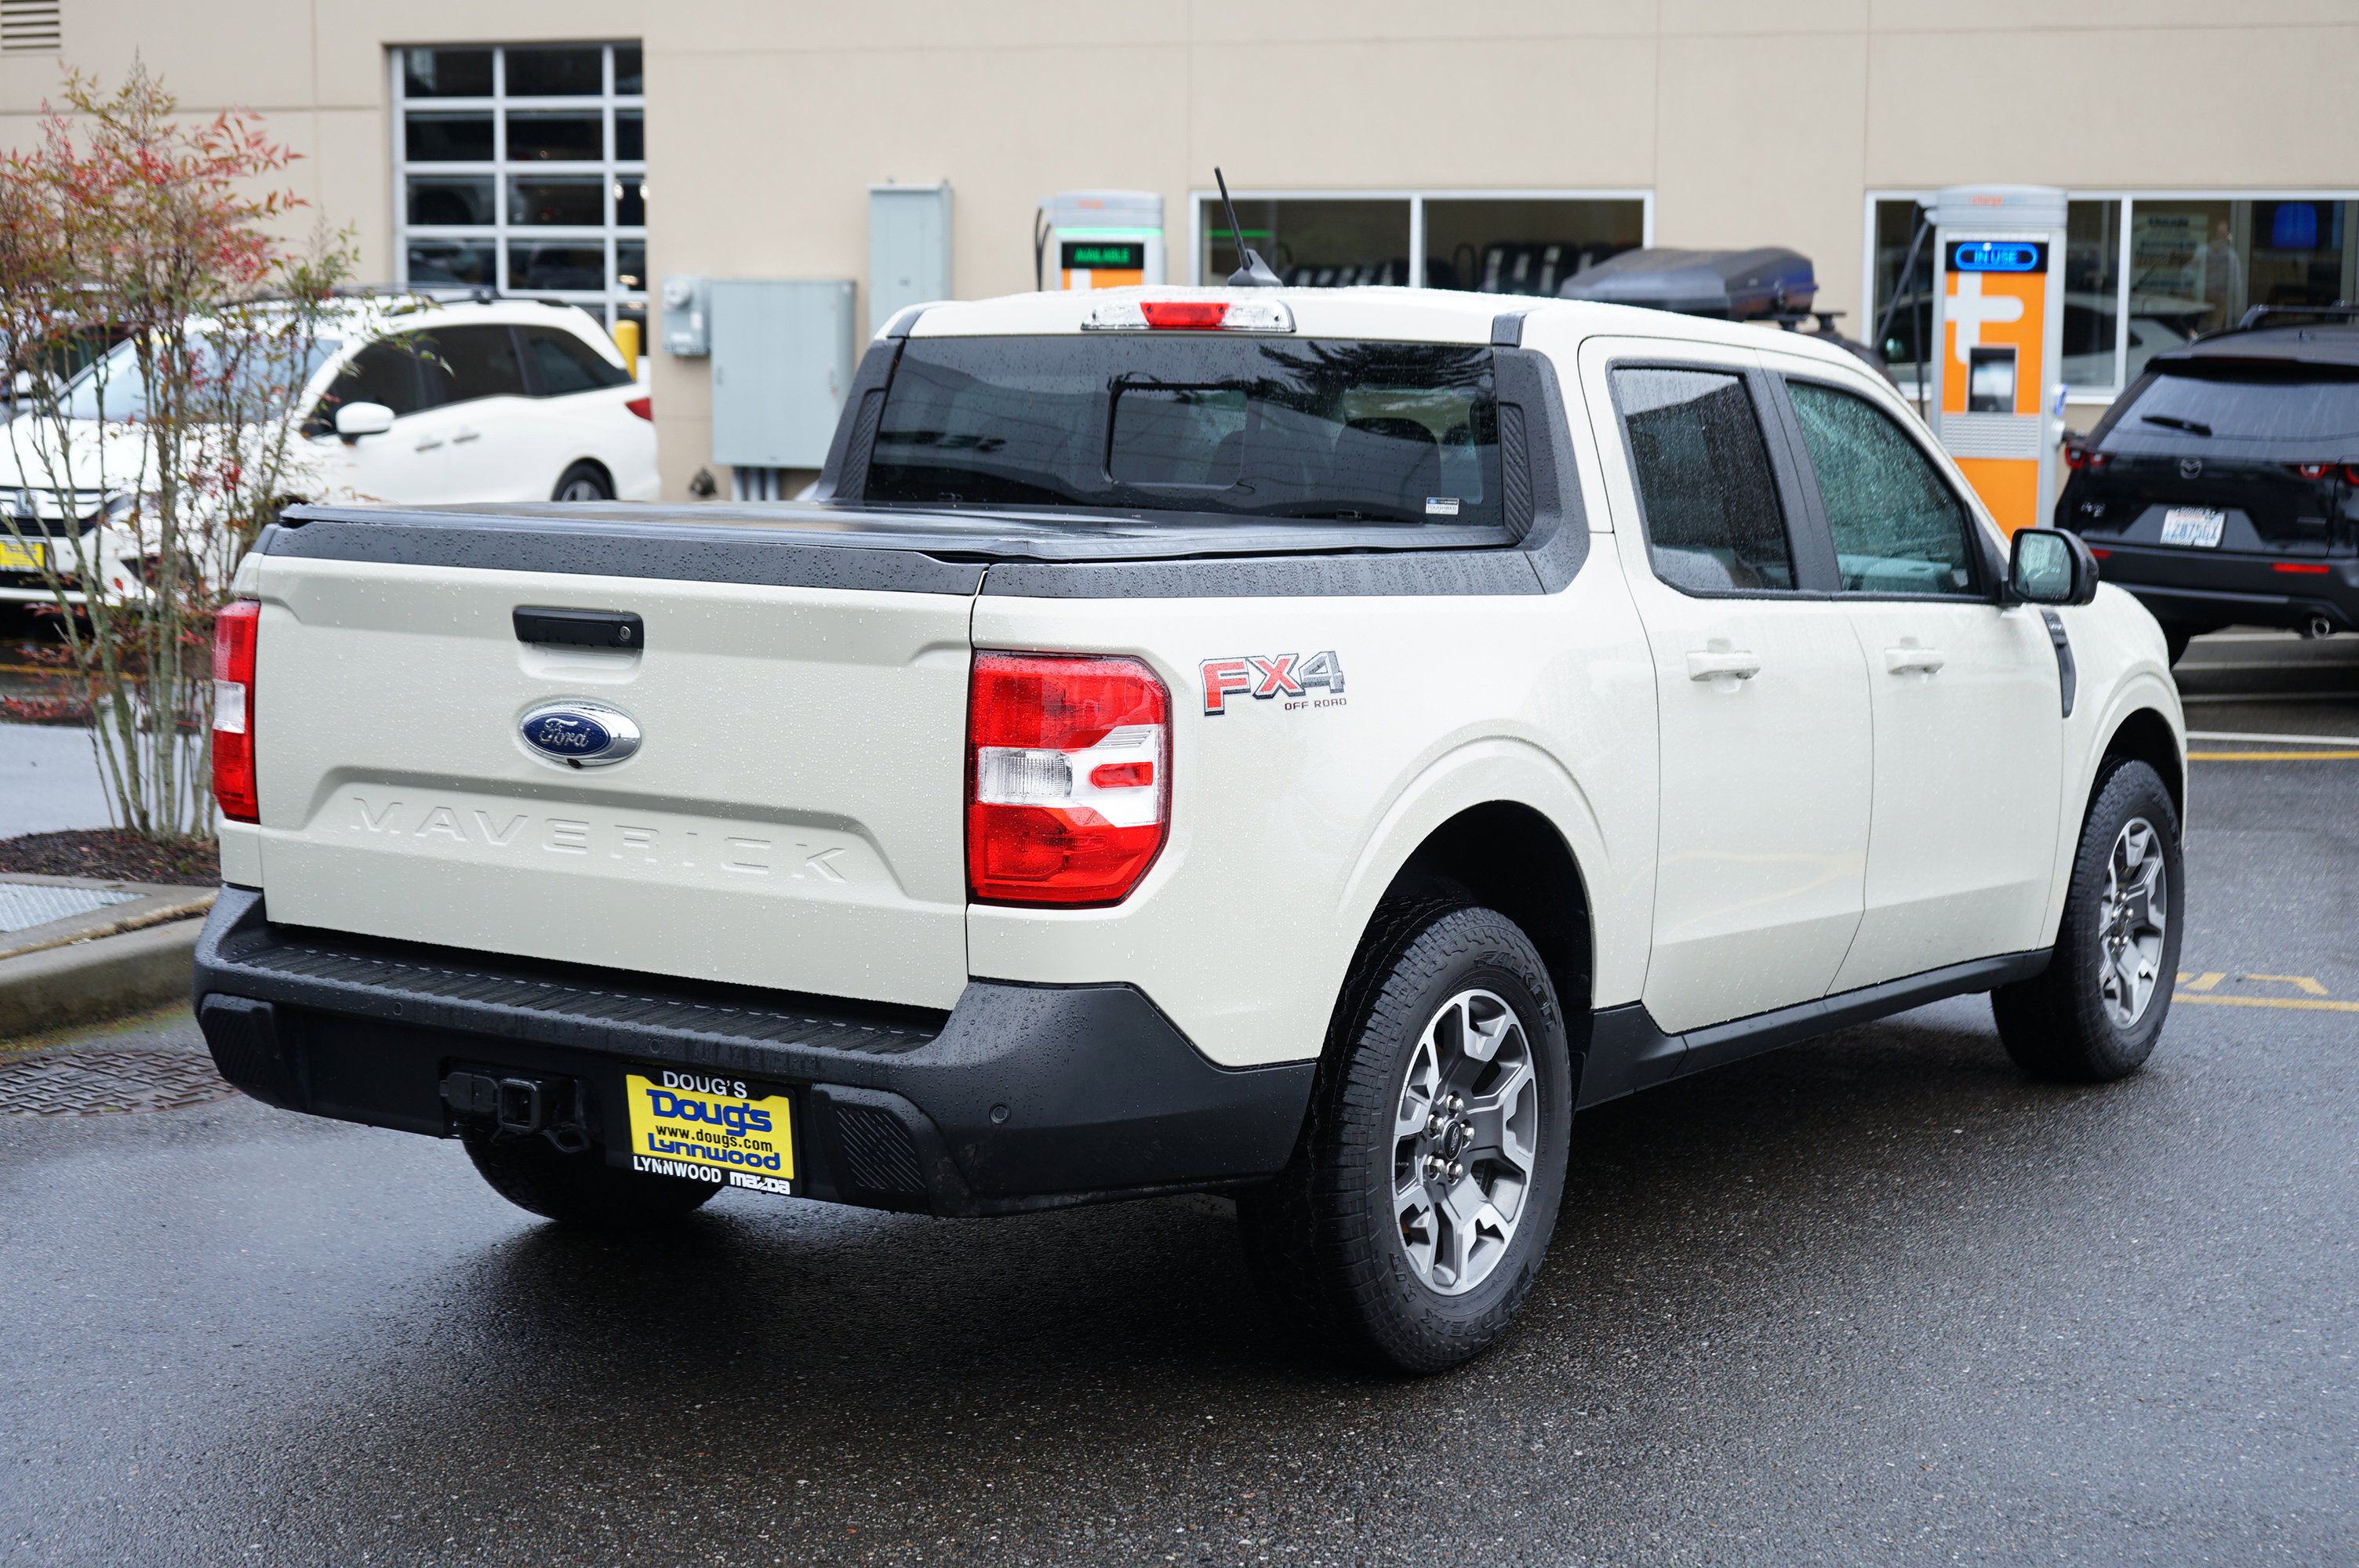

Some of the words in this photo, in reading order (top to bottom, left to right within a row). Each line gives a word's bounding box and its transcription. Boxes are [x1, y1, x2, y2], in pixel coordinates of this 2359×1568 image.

[1074, 248, 1129, 263] AVAILABLE
[1199, 650, 1345, 717] FX4
[1285, 702, 1309, 710] OFF
[1314, 698, 1347, 708] ROAD
[540, 718, 591, 747] Ford
[350, 797, 847, 883] MAVERICK
[663, 1070, 747, 1098] DOUG'S
[648, 1133, 781, 1171] Lynnwood
[656, 1125, 773, 1152] www.dougs.com
[633, 1156, 722, 1183] LYNNWOOD
